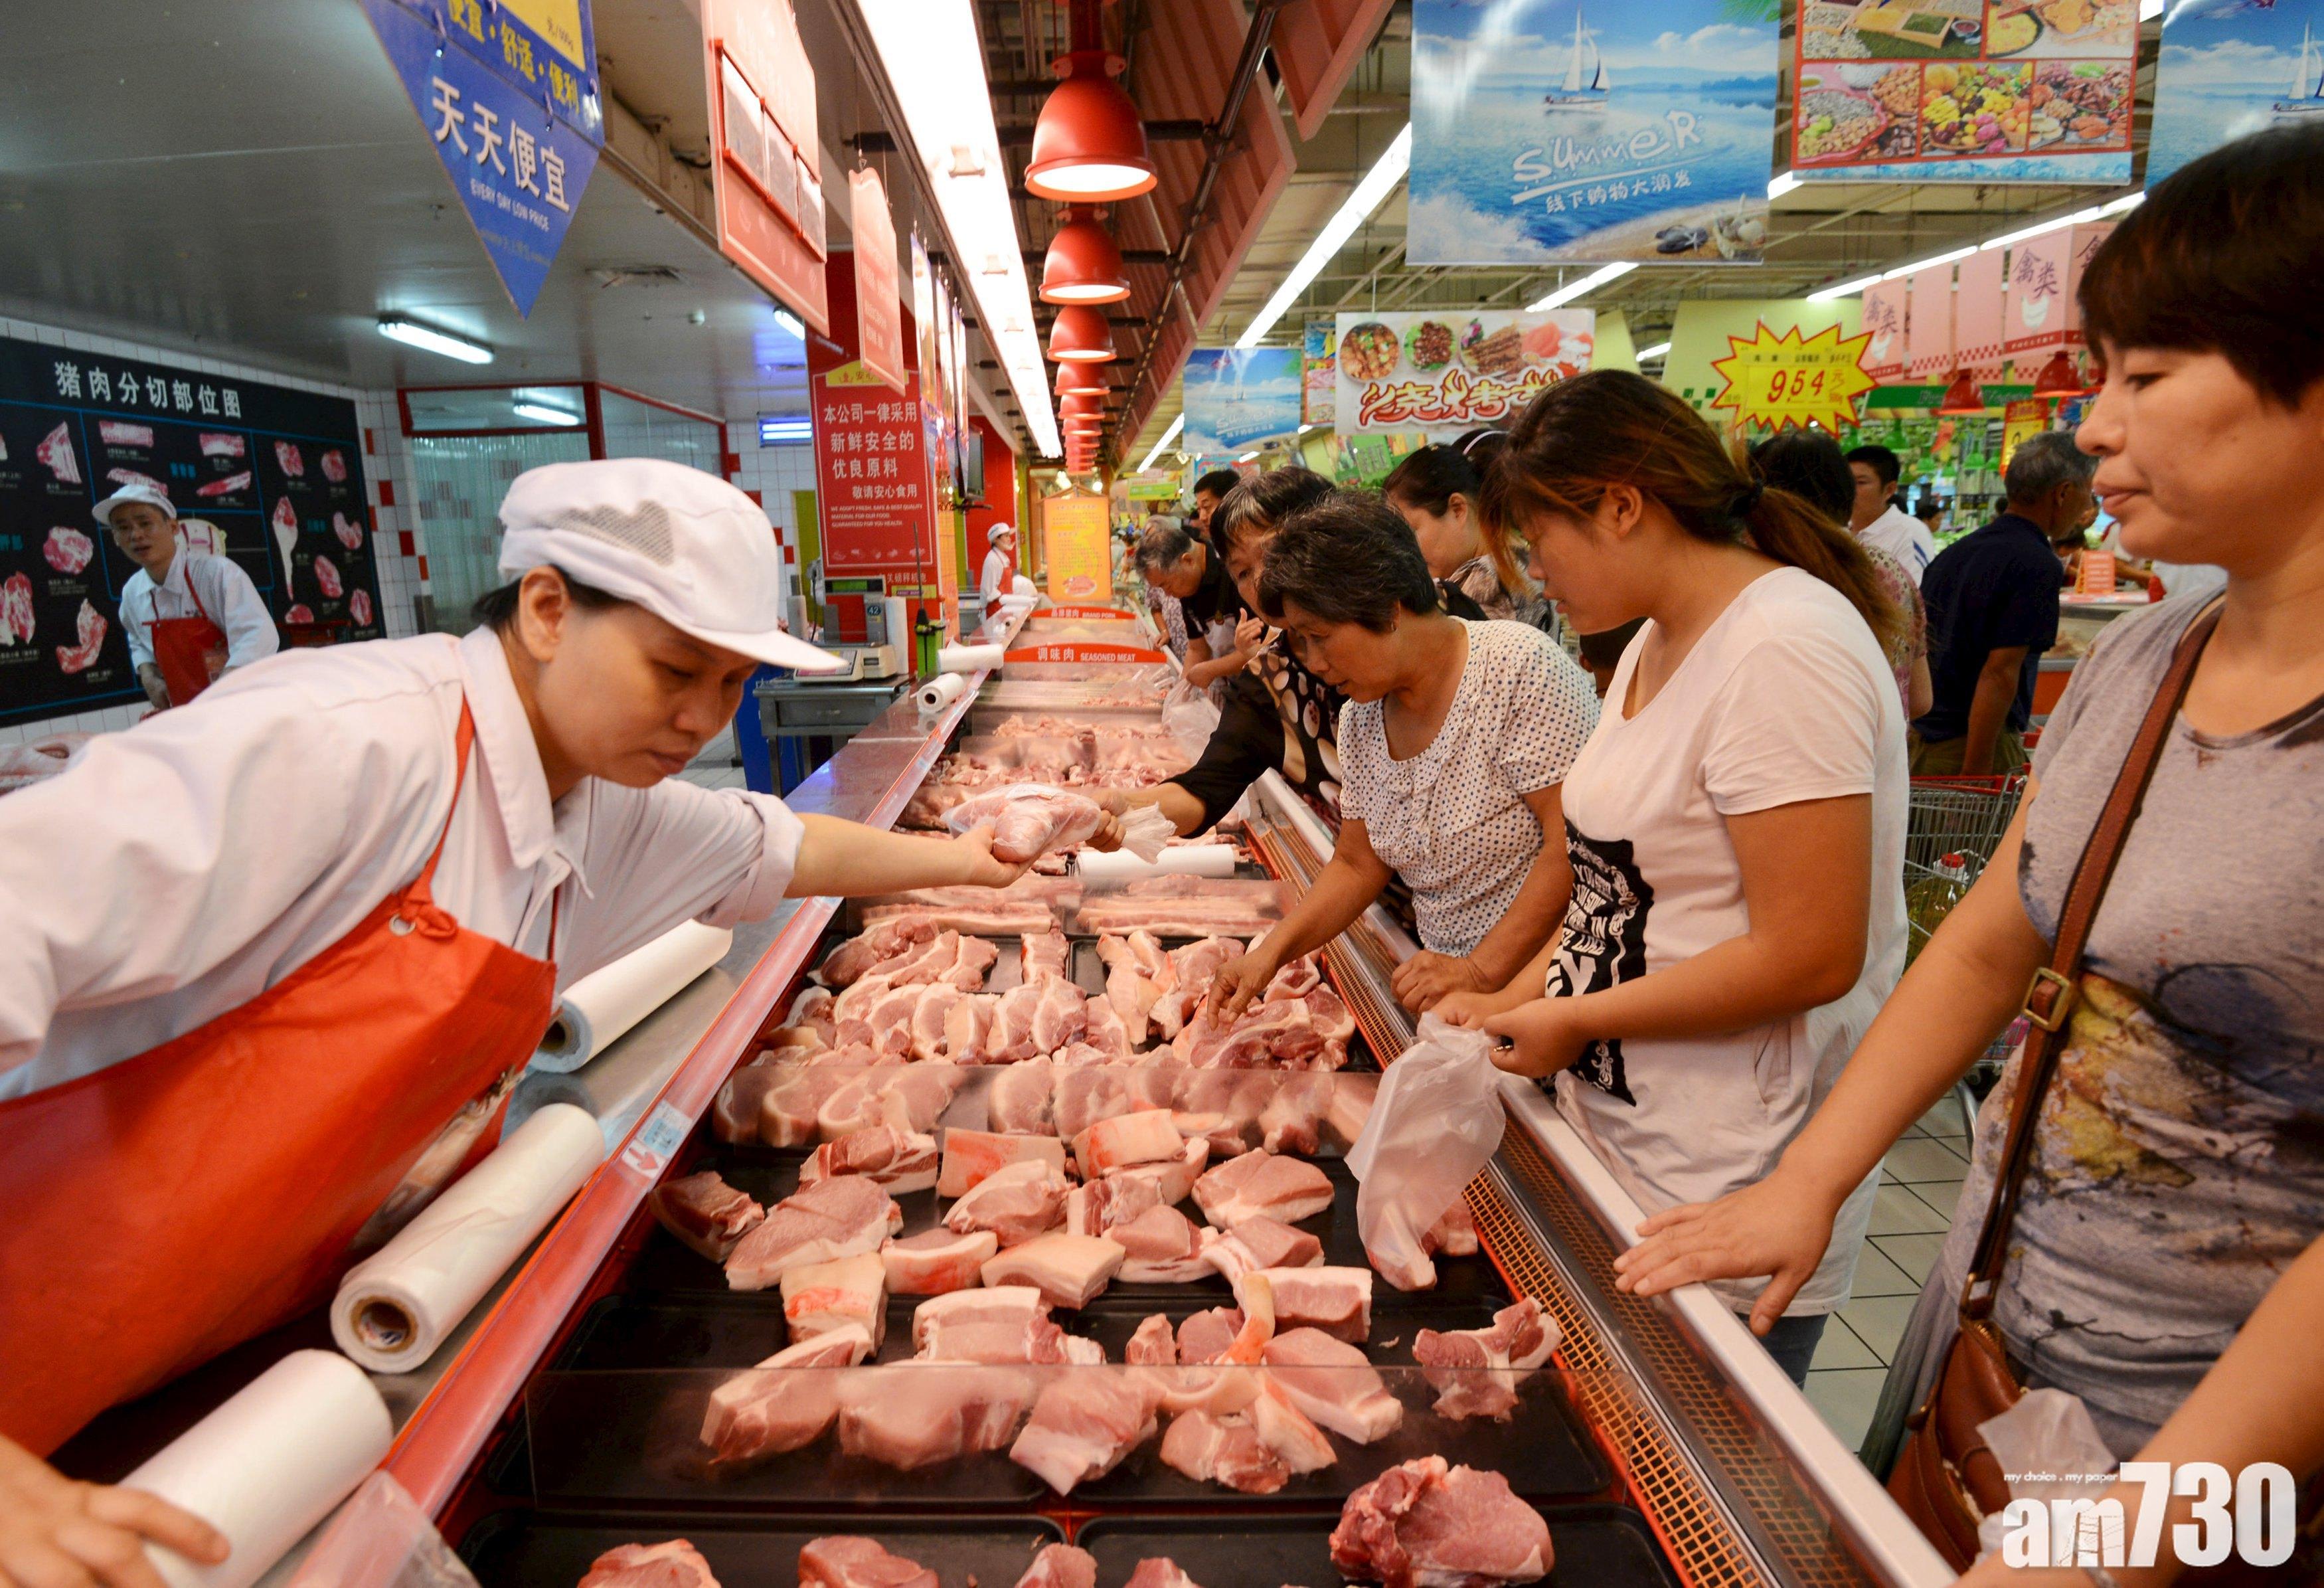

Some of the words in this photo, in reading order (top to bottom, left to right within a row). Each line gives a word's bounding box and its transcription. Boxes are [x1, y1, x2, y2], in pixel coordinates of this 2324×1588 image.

[432, 76, 570, 213] 天天便宜
[1546, 169, 1692, 214] 线下购物大润发
[2013, 246, 2059, 299] 禽类
[1865, 292, 1898, 335] 禽类
[54, 361, 242, 419] 猪肉分切部位图
[823, 401, 917, 424] 本公司一律采用
[830, 430, 914, 453] 新鲜安全的
[832, 456, 898, 480] 优良原料
[852, 483, 918, 499] 敬请安心食用
[869, 606, 878, 615] 42
[1037, 646, 1074, 662] 调味肉
[1080, 652, 1116, 662] SEASONED
[1117, 654, 1136, 662] MEAT
